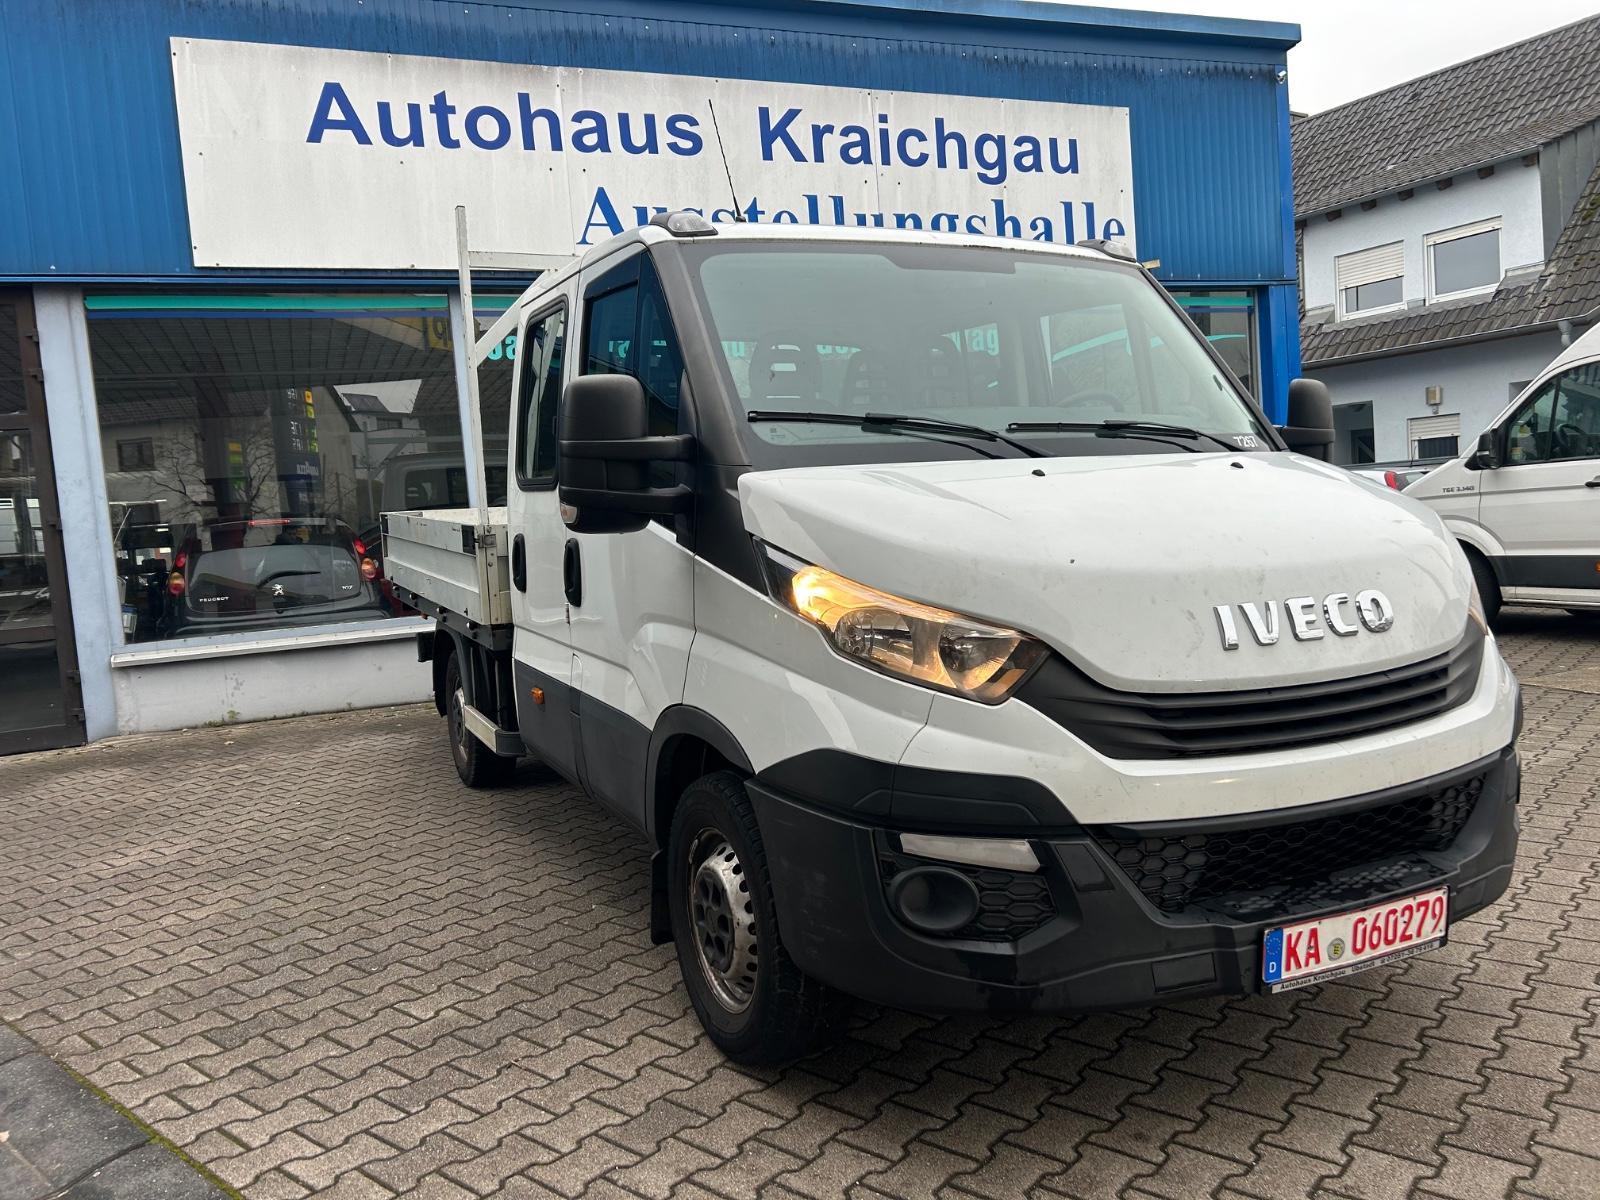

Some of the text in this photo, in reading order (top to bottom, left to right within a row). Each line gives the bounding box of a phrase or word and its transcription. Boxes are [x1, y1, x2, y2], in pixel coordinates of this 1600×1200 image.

[307, 82, 1079, 185] Autohaus Kraichgau
[577, 187, 1125, 245] Atllshalle
[1213, 589, 1394, 651] IVECO
[1269, 896, 1444, 973] D KA 060279
[1280, 979, 1312, 990] Autohaus
